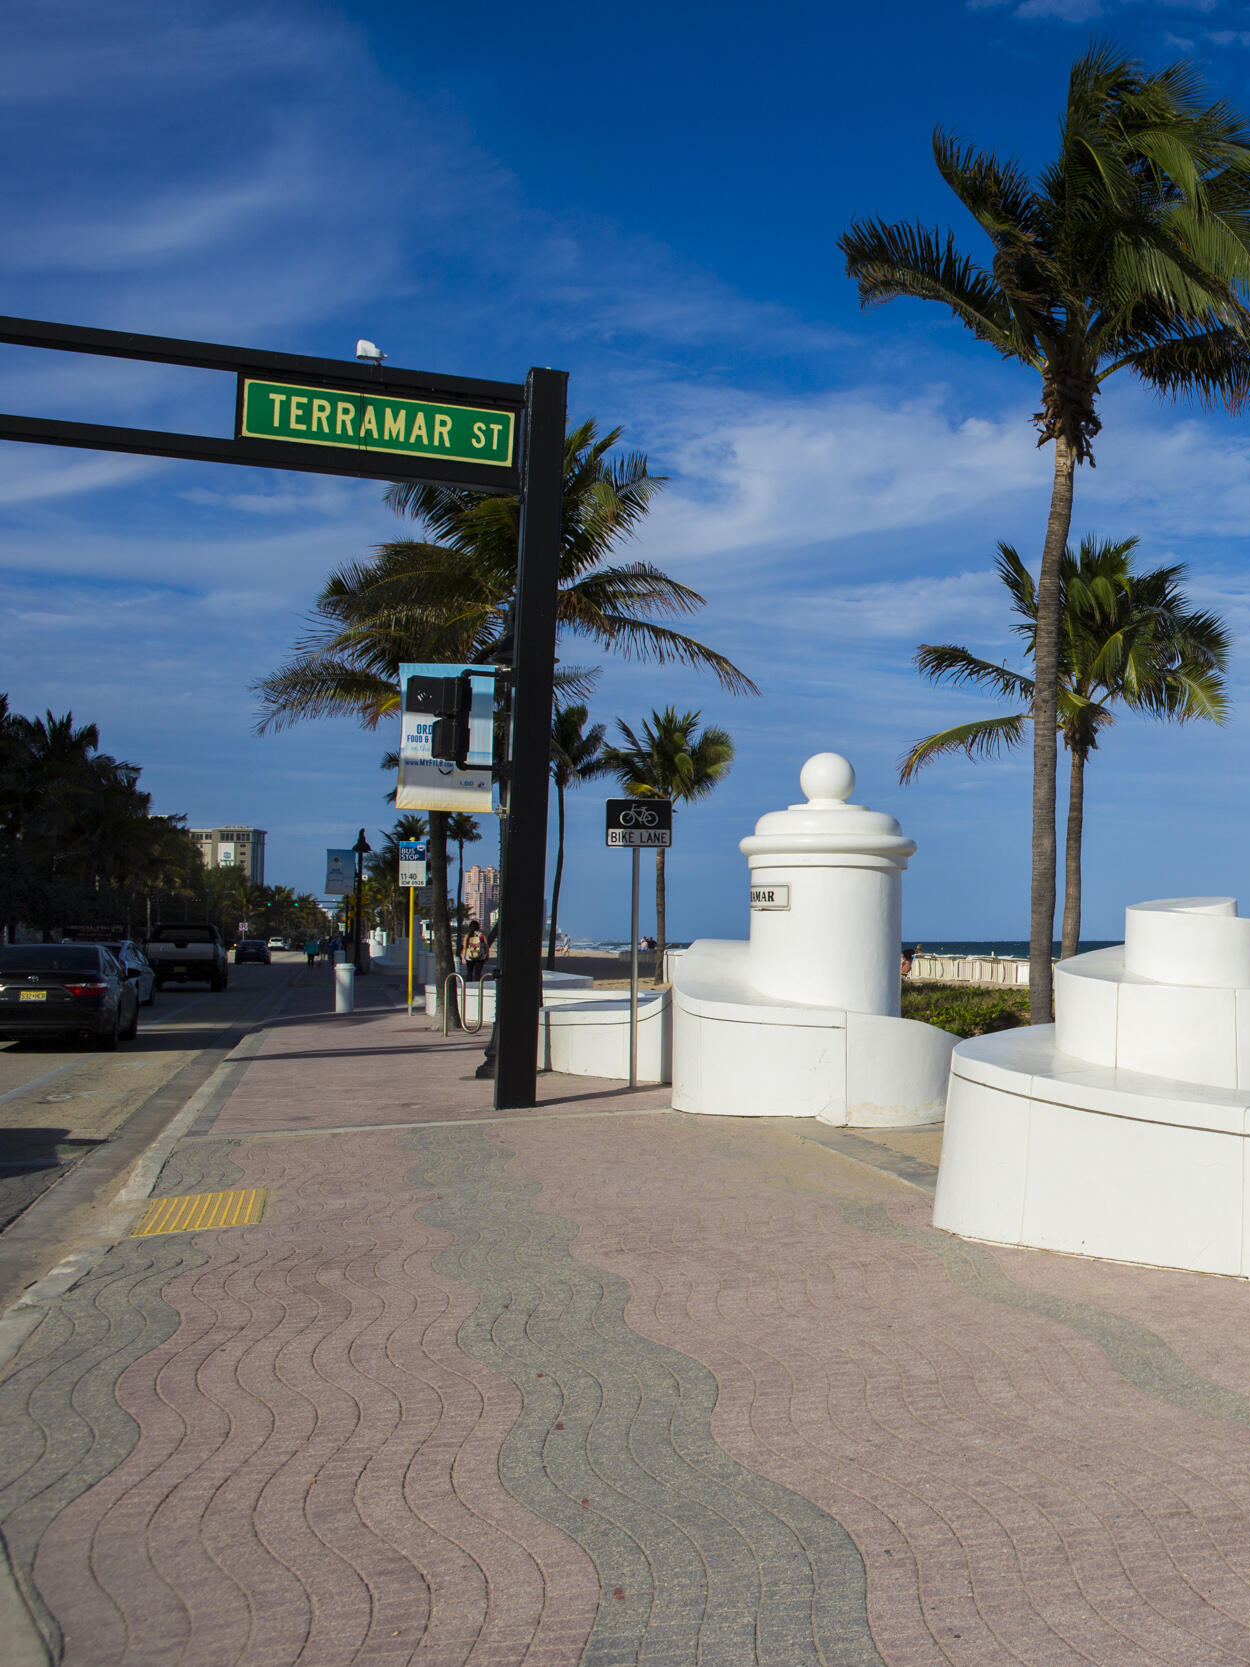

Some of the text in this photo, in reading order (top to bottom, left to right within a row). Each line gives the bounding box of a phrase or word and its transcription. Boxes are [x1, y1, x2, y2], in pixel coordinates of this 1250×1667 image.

[269, 393, 502, 450] TERRAMAR ST
[417, 723, 433, 735] ORD
[407, 734, 423, 743] FOOD
[611, 831, 667, 843] BIKE LANE
[401, 853, 420, 861] STOP
